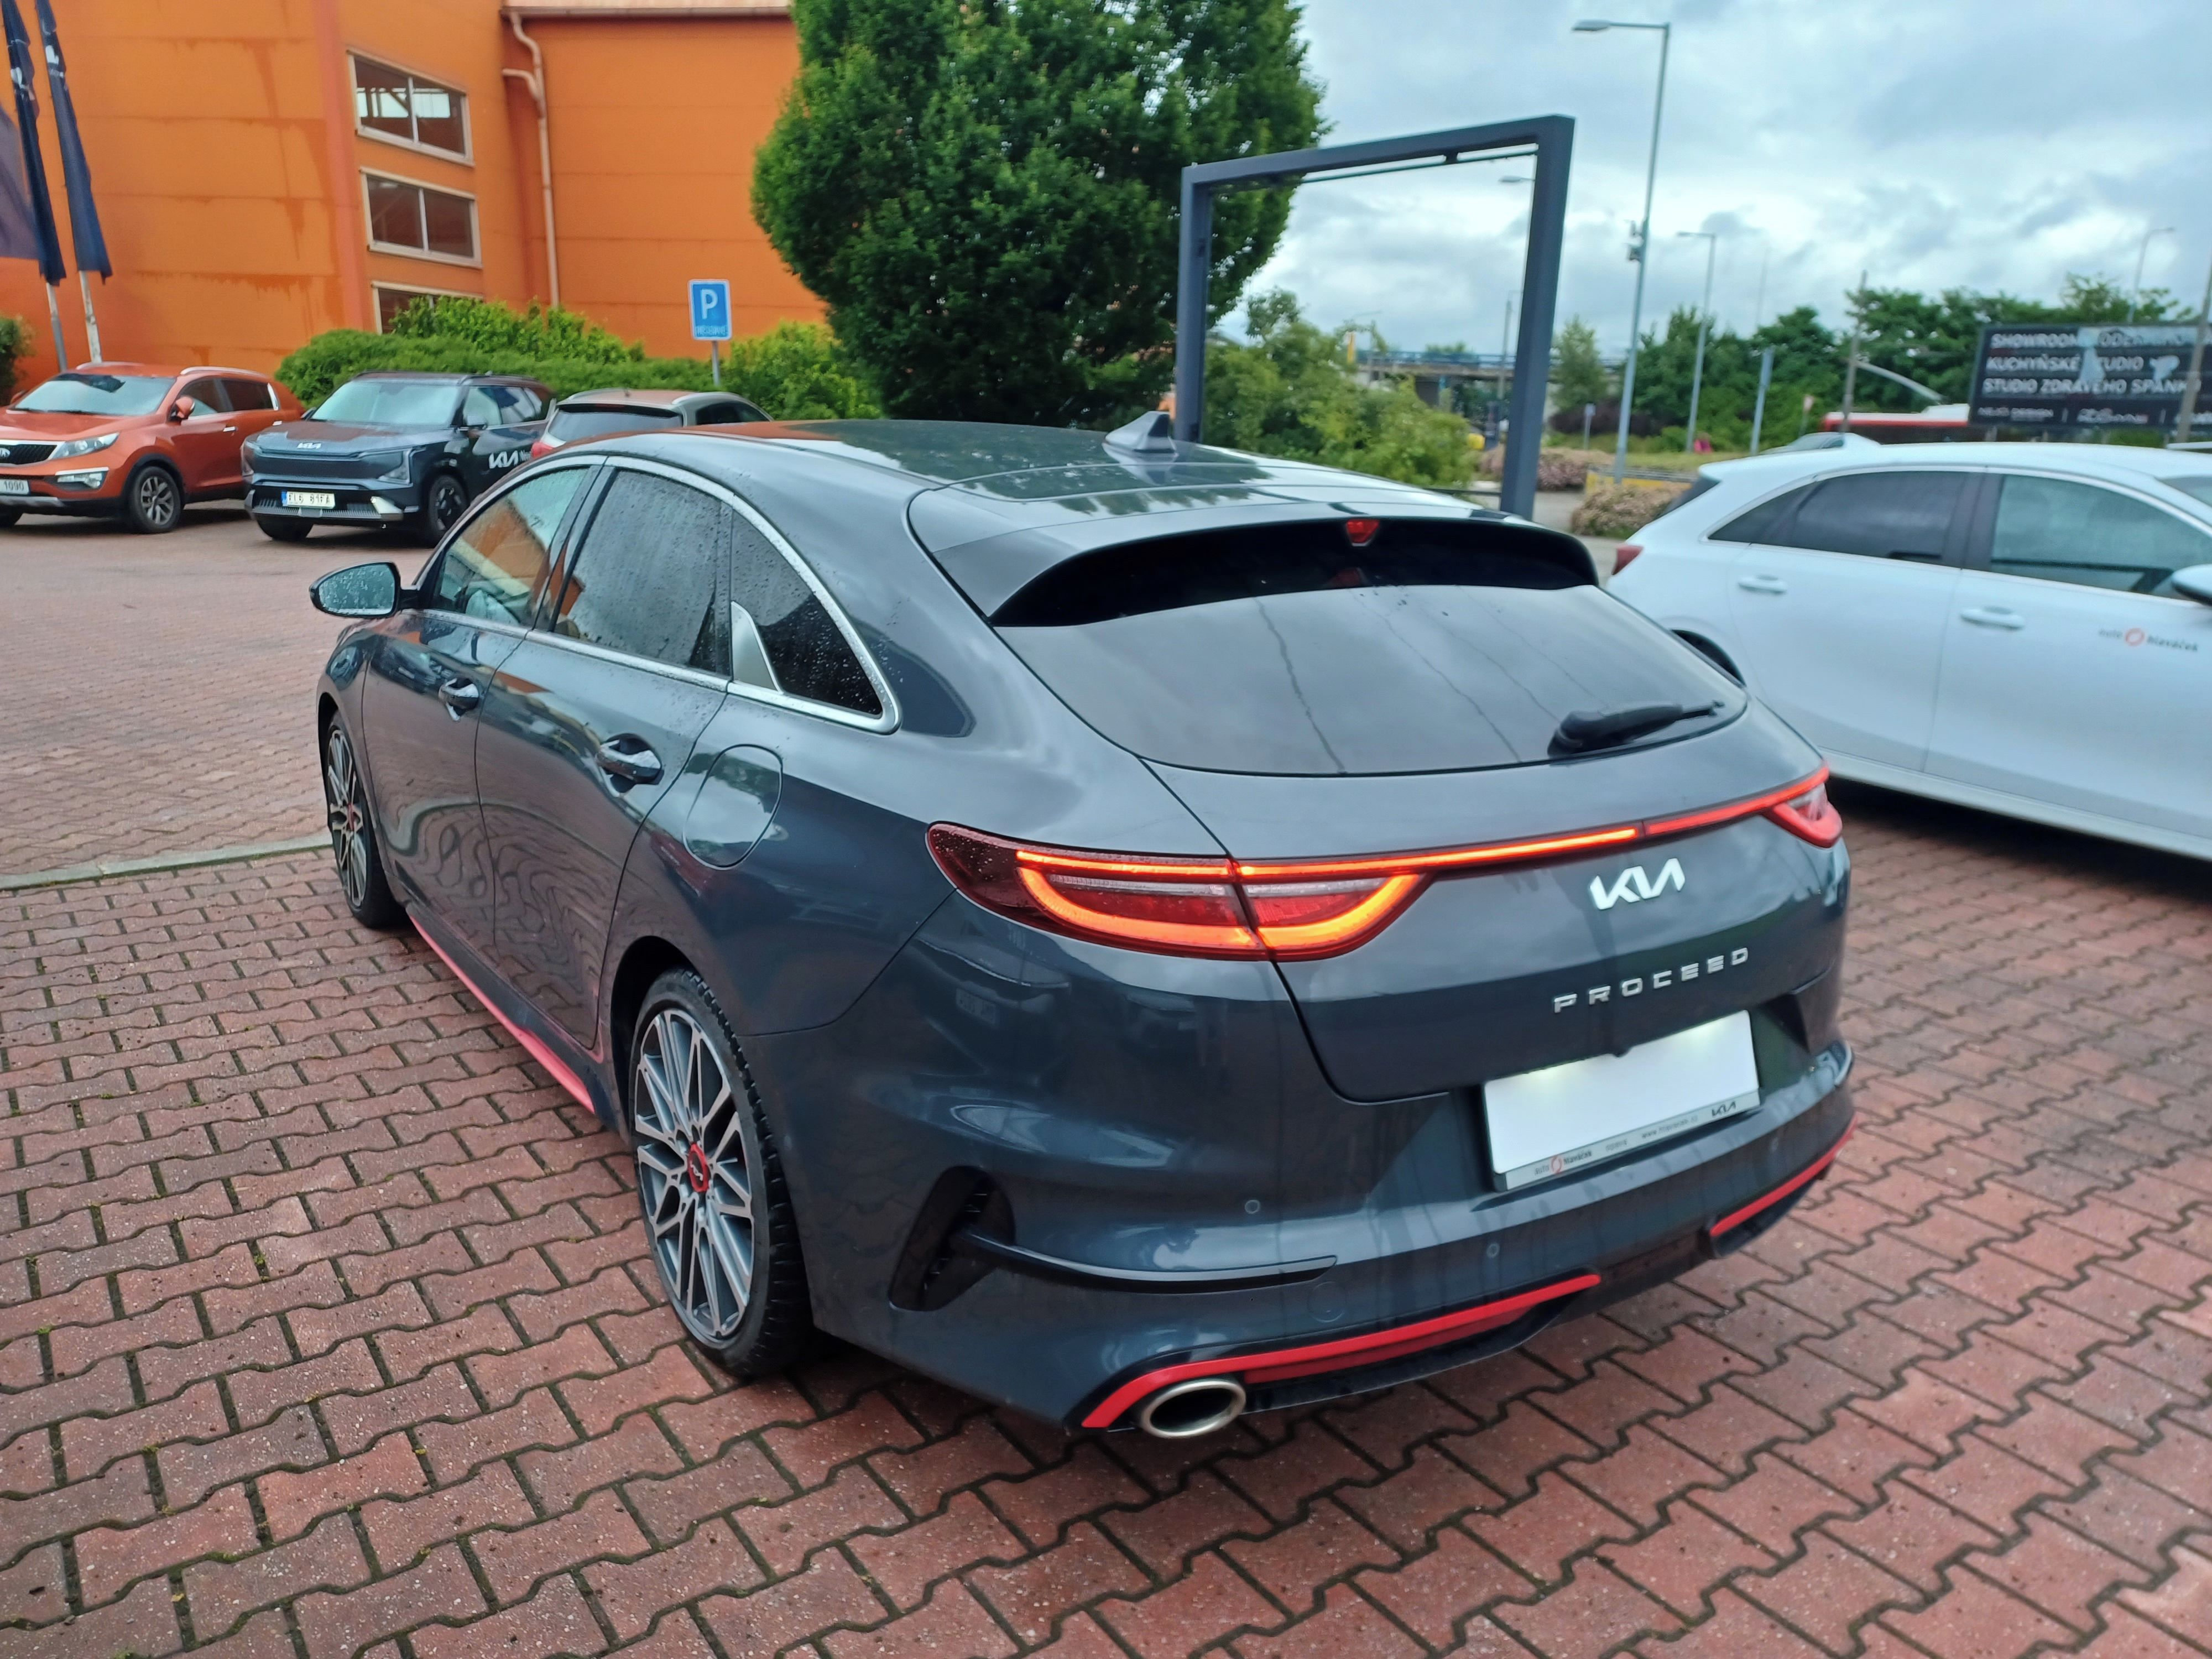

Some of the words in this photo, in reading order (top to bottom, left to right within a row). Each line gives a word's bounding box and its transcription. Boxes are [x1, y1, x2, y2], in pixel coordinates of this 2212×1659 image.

[700, 288, 718, 320] P
[488, 450, 519, 469] KIA
[1590, 858, 1685, 910] KIA
[1554, 947, 1749, 1013] PROCEED
